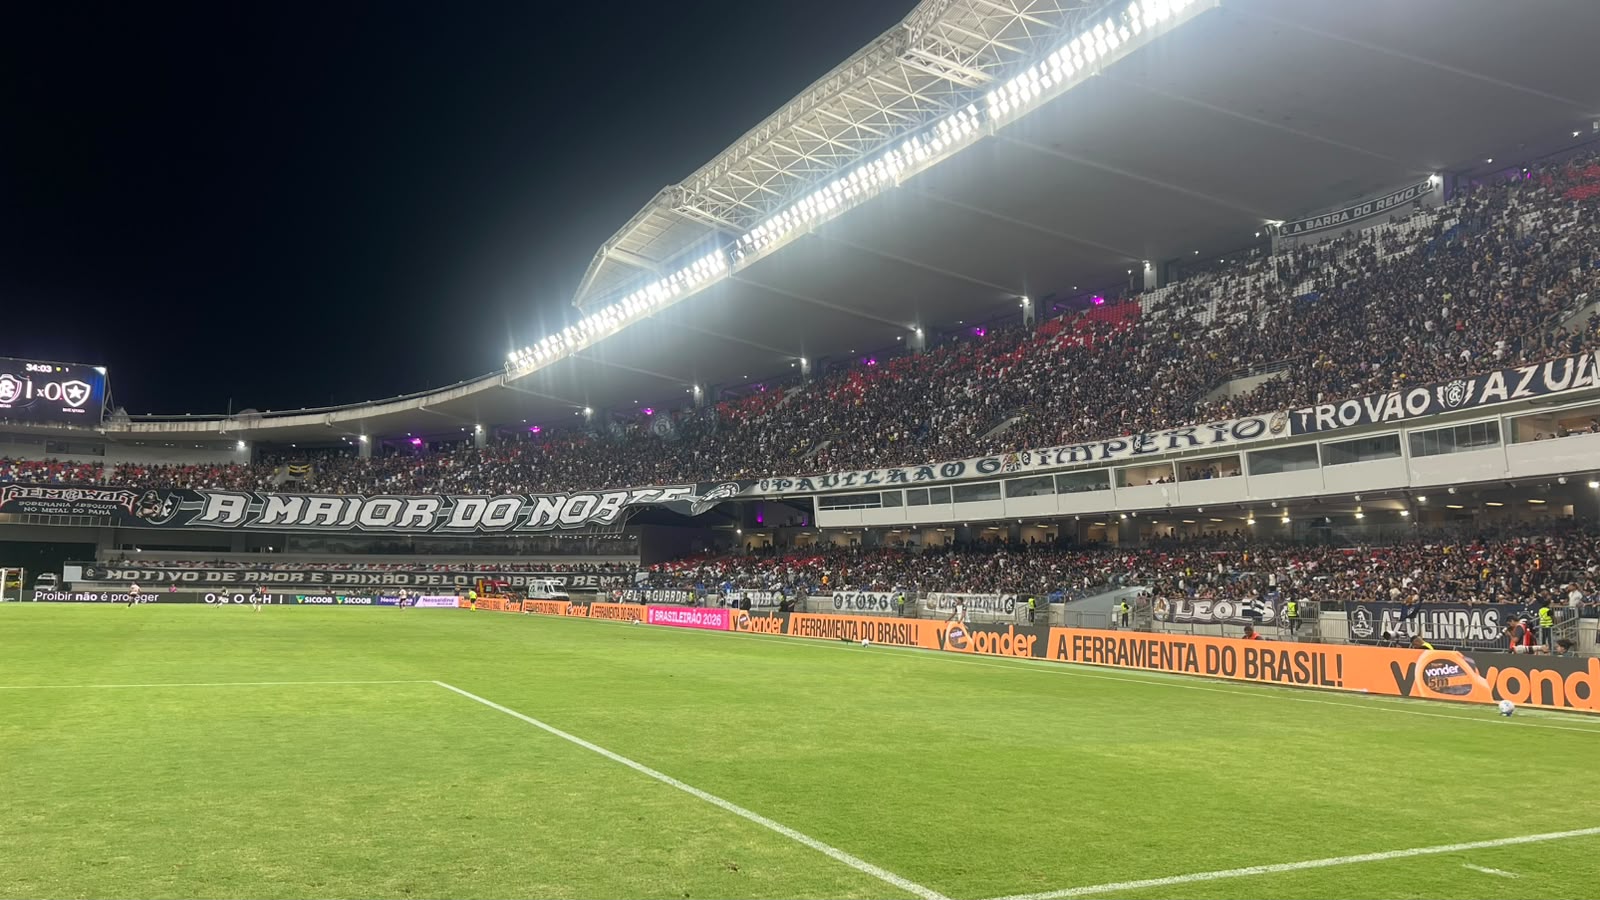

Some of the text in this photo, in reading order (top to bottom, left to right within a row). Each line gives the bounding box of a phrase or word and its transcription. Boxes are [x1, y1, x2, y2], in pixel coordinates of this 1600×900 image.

[1293, 188, 1415, 233] A BARRA DO REMO
[26, 363, 52, 373] 34:03
[1295, 387, 1431, 431] TROVÃO
[1478, 353, 1593, 403] AZUL
[975, 458, 1002, 474] 6
[201, 492, 248, 523] A
[259, 495, 439, 528] MAIOR
[446, 497, 523, 528] DO
[106, 570, 199, 581] MOTIVO
[205, 571, 237, 582] DE
[244, 571, 304, 582] AMOR
[311, 573, 325, 582] E
[331, 573, 409, 585] PAIXÃO
[414, 574, 468, 586] PELO
[473, 575, 537, 587] CUBE
[33, 591, 159, 603] Proibir não é proeger
[655, 609, 722, 626] BRASILEIRÃO 2026
[1380, 608, 1499, 640] AZULINDAS
[792, 617, 919, 646] A FERRAMENTA DO BRASIL!
[1056, 634, 1344, 688] A FERRAMENTA DO BRASIL!
[1425, 663, 1460, 677] vonder
